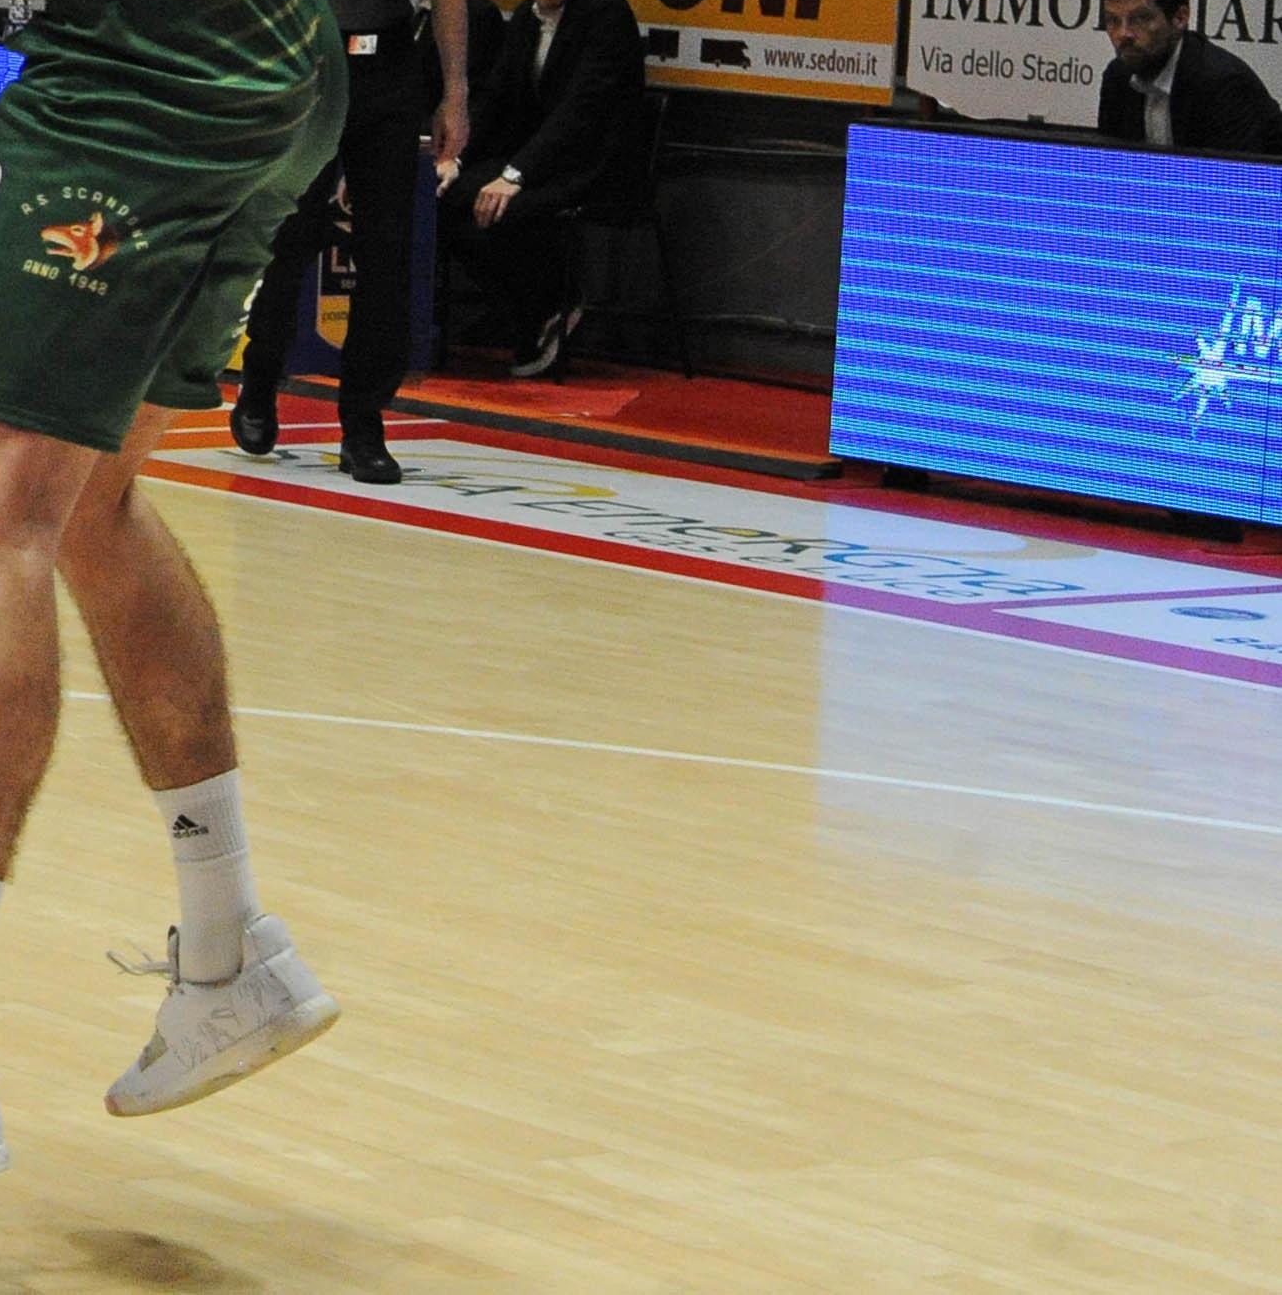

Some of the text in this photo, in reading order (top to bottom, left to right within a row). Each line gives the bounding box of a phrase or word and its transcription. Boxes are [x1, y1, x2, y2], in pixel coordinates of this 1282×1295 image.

[763, 46, 878, 78] www.sedoni.it
[921, 46, 1094, 86] Via dello Stadio
[22, 259, 109, 297] ANNO 1948
